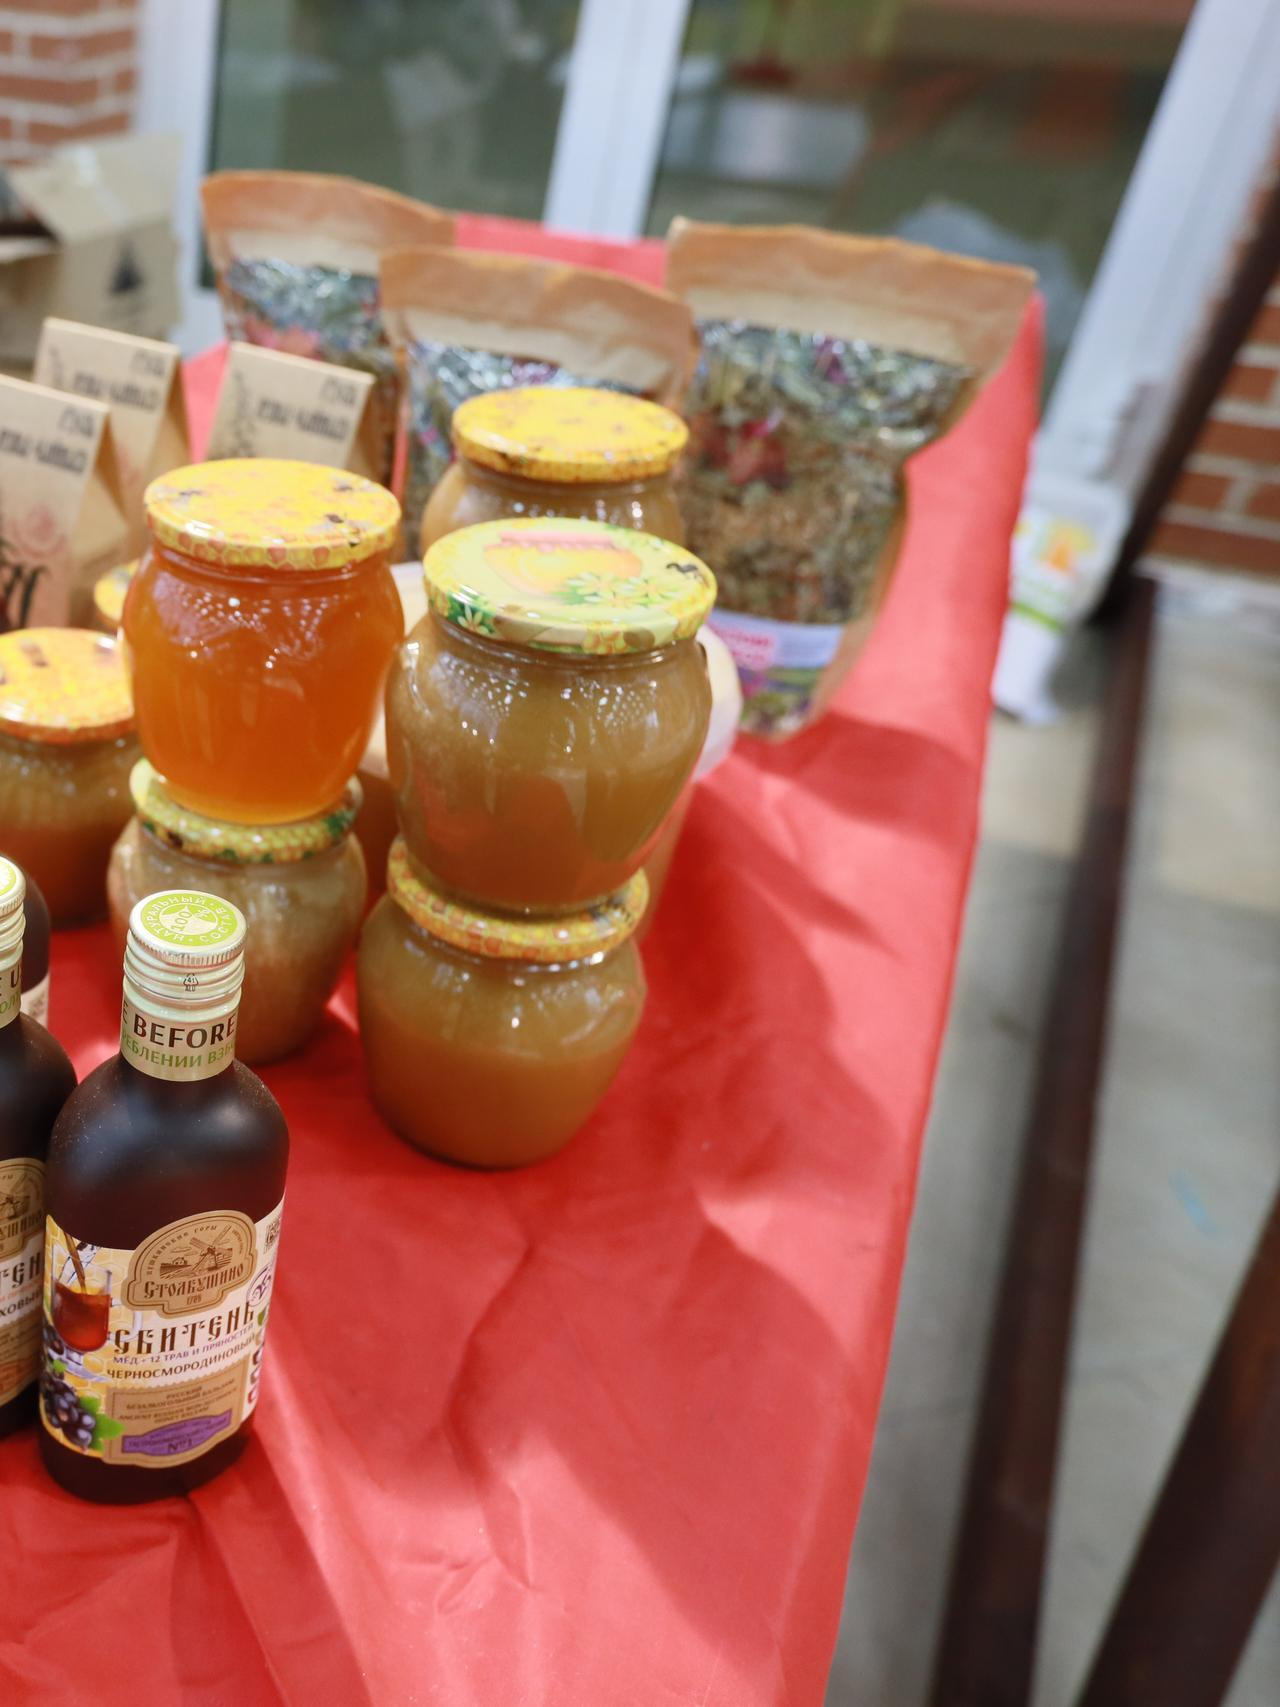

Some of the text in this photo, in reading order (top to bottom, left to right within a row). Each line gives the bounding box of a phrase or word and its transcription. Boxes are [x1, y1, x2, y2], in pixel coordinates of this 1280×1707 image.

[146, 895, 207, 942] НАТУРАЛЬНЫЙ
[199, 905, 234, 943] СОСТАВ
[133, 1012, 237, 1049] BEFORE
[113, 1300, 255, 1356] СБИТЕНЬ
[106, 1331, 257, 1380] ЧЕРНОСМОРОДИНОВЫЙ
[150, 1355, 161, 1363] 12
[164, 1351, 189, 1361] ТРАВ
